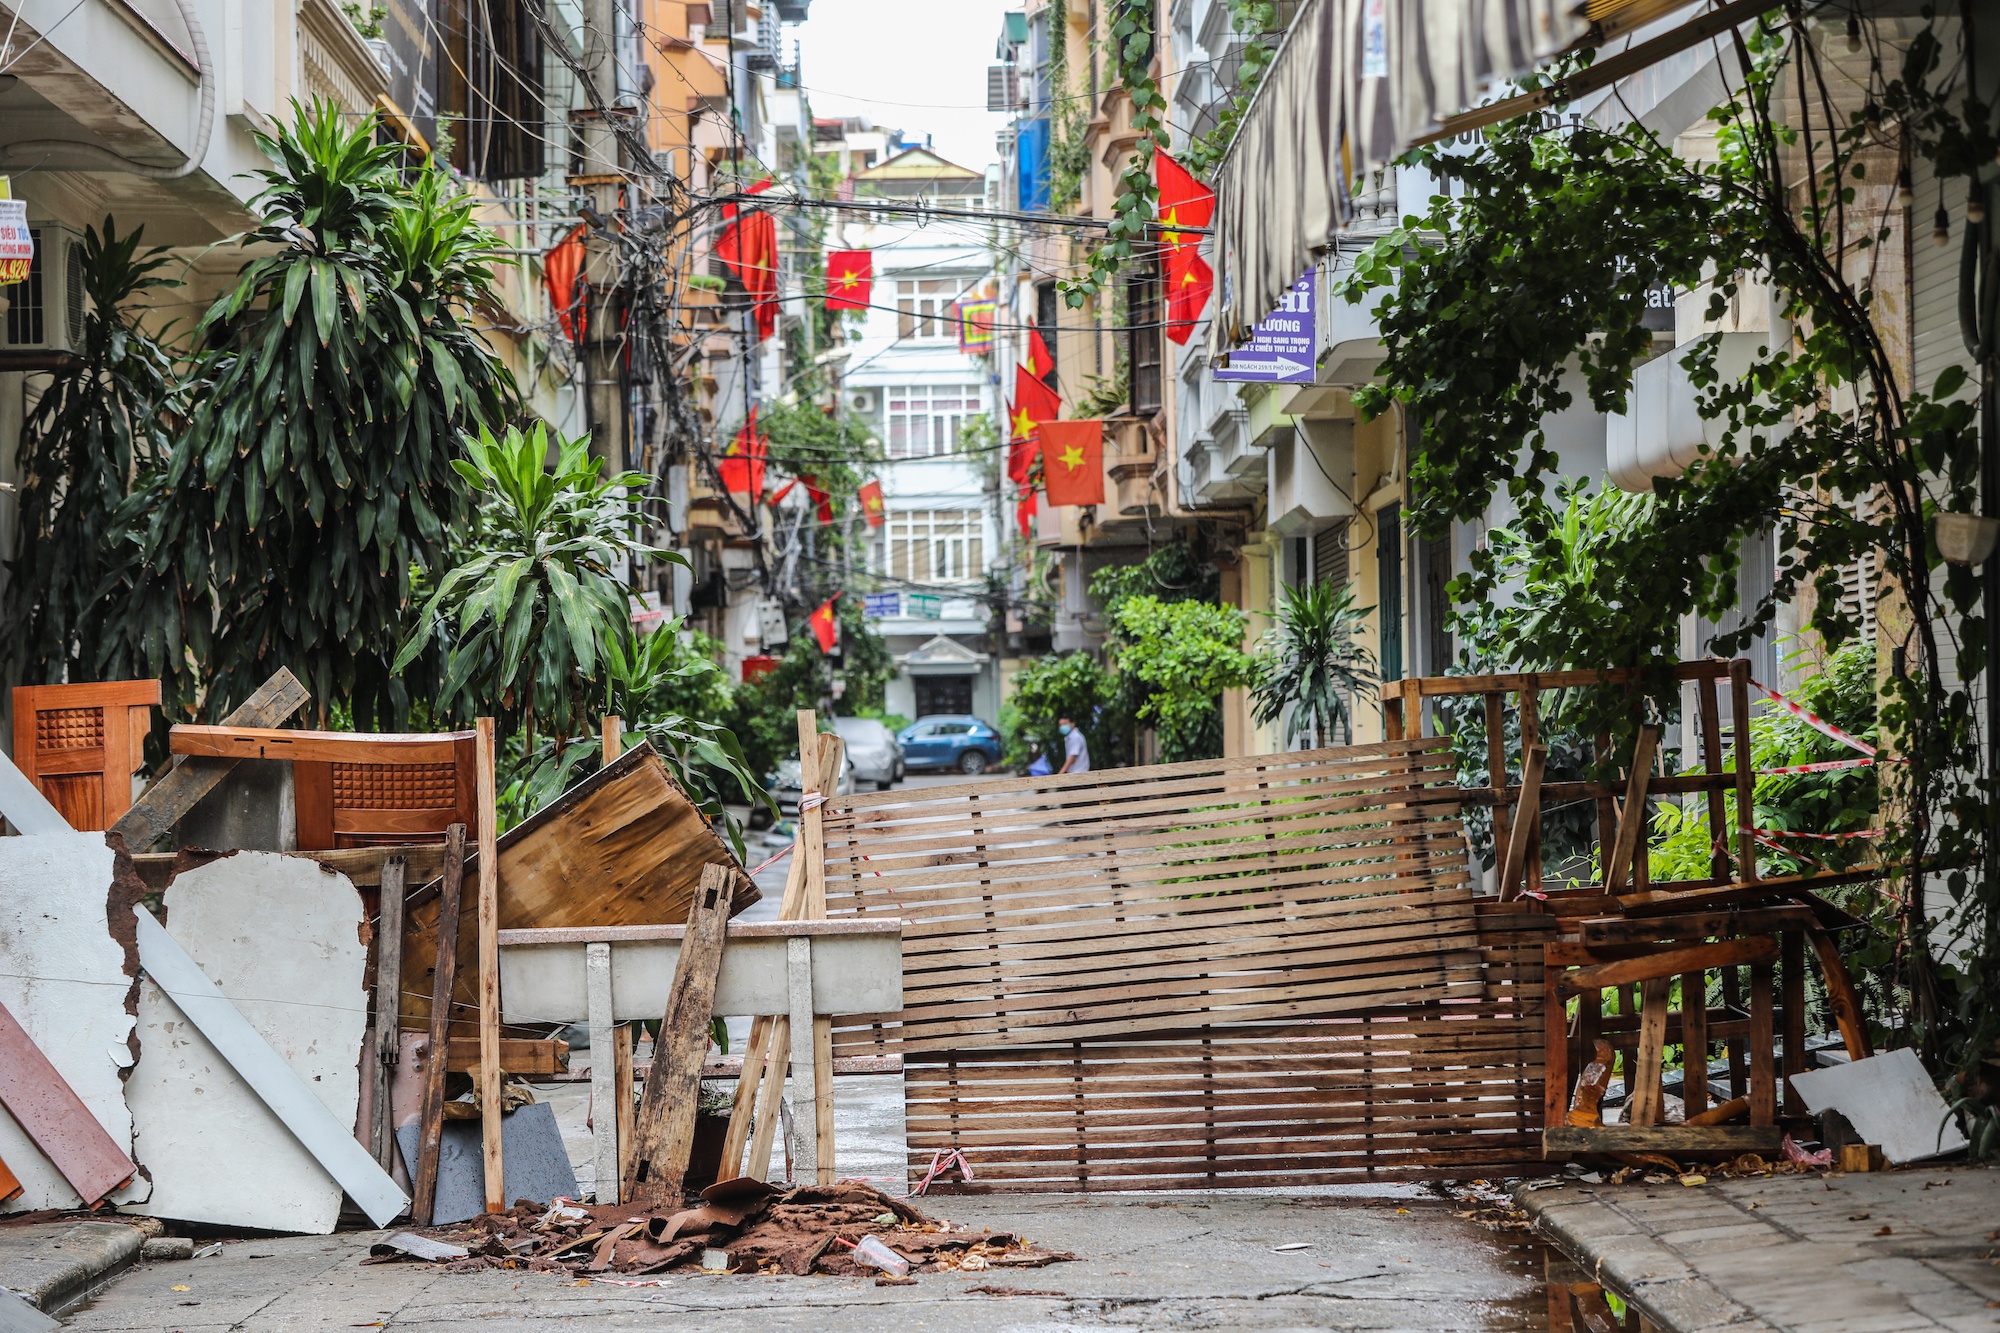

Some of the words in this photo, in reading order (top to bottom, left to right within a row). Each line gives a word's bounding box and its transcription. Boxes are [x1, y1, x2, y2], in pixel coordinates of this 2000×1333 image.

[0, 259, 28, 280] 4.924
[1259, 318, 1301, 333] LƯƠNG
[1273, 336, 1289, 345] SANG
[1290, 337, 1310, 346] TRỌNG
